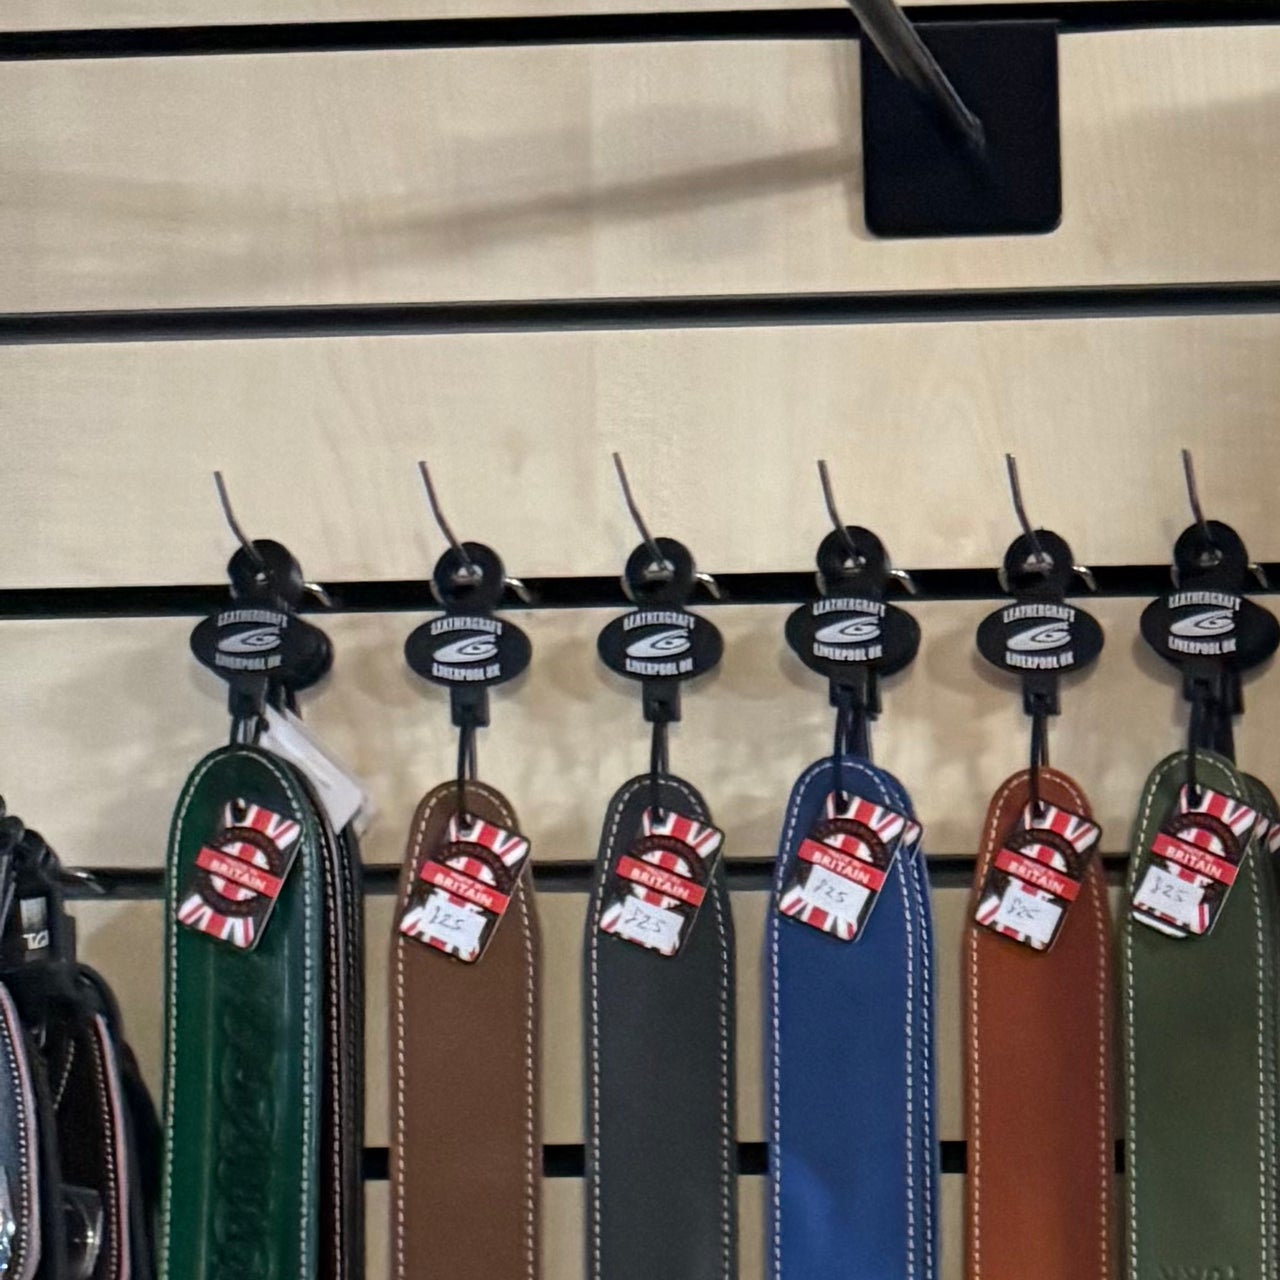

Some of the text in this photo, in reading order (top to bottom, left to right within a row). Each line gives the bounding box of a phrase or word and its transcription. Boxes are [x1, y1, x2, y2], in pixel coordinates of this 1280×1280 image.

[812, 599, 886, 618] LEATHERCRAFT
[1168, 592, 1241, 611] LEATHERCRAFT
[218, 609, 288, 628] LEATHERCRAFT
[623, 610, 695, 631] LEATHERCRAFT
[1003, 604, 1075, 623] LEATHERCRAFT
[431, 617, 502, 635] LEATHERCRAFT
[813, 643, 866, 661] LIVERPOOL
[1168, 635, 1221, 655] LIVERPOOL
[216, 653, 266, 670] LIVERPOOL
[625, 657, 676, 676] LIVERPOOL
[1005, 651, 1059, 670] LIVERPOOL
[432, 663, 484, 681] LIVERPOOL
[812, 850, 871, 885] BRITAIN
[1167, 844, 1222, 879] BRITAIN
[210, 858, 267, 891] BRITAIN
[630, 867, 691, 900] BRITAIN
[1008, 860, 1066, 896] BRITAIN
[434, 872, 494, 909] BRITAIN
